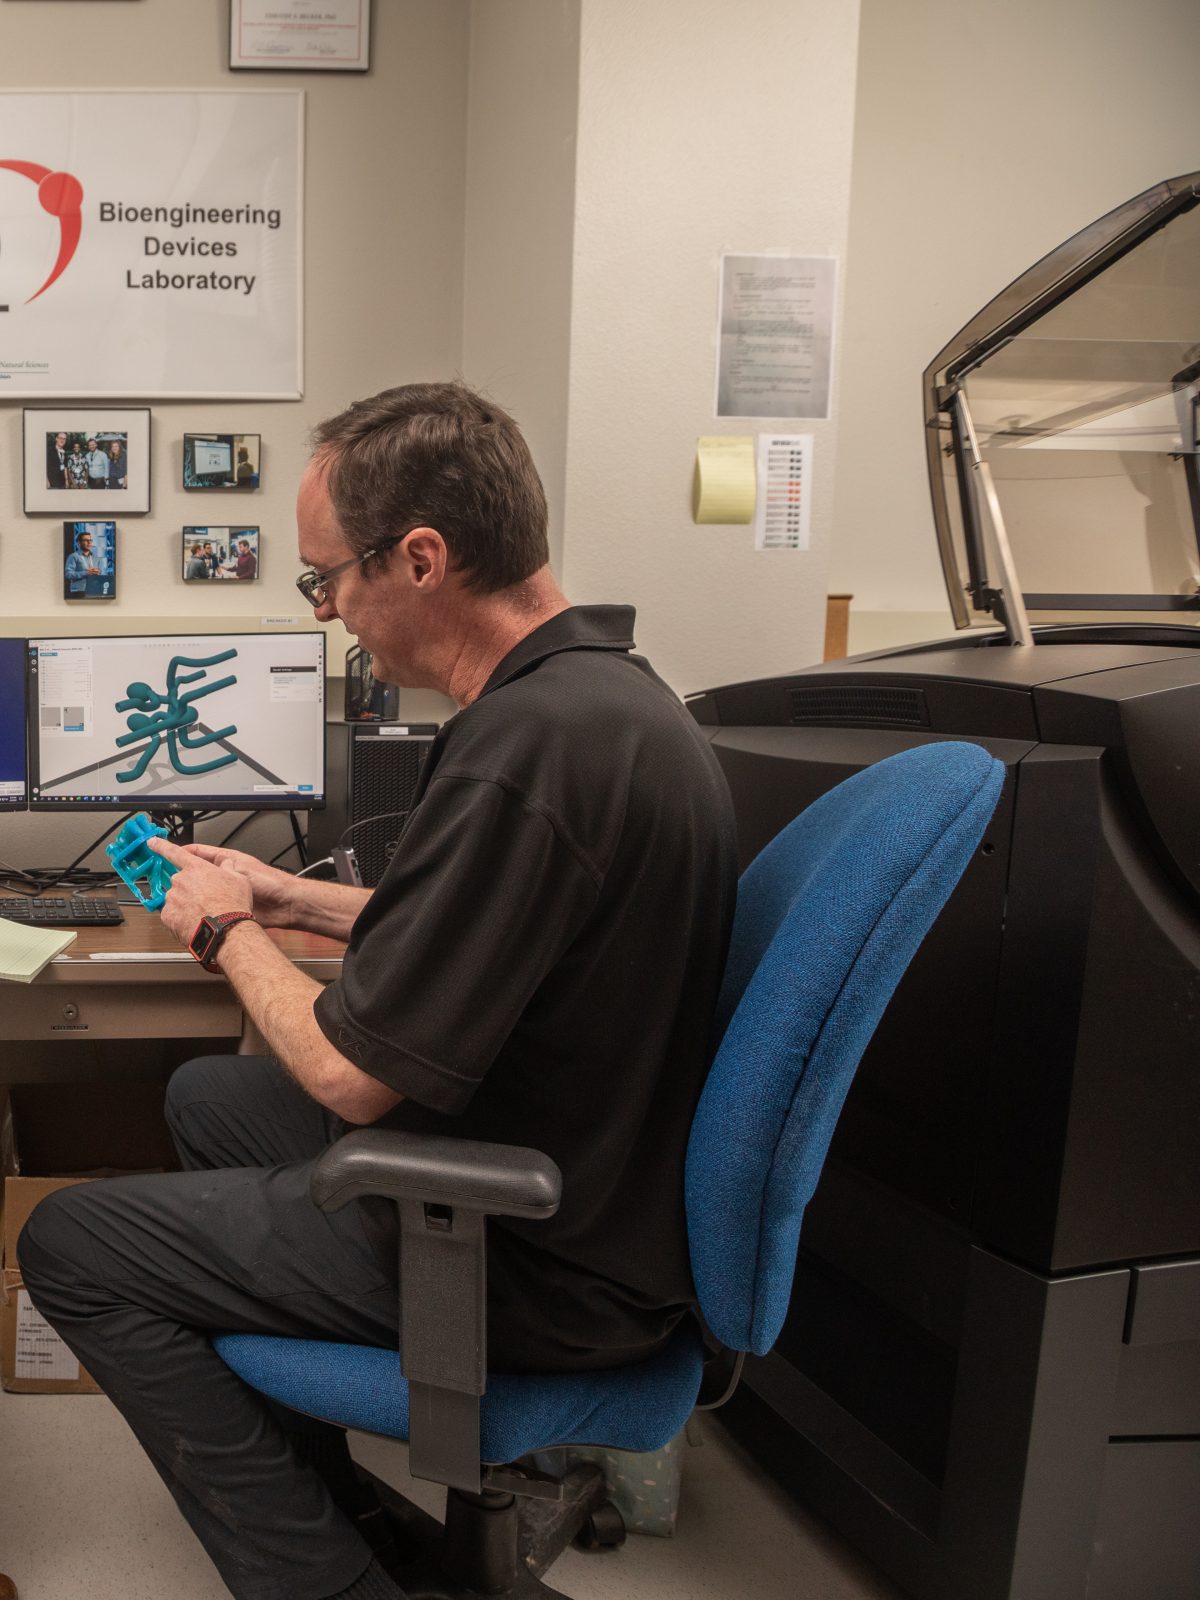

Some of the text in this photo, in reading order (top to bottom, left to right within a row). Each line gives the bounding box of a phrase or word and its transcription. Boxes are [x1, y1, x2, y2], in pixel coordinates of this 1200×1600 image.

[100, 202, 281, 229] Bioengineering
[144, 236, 238, 257] Devices
[126, 269, 256, 295] Laboratory
